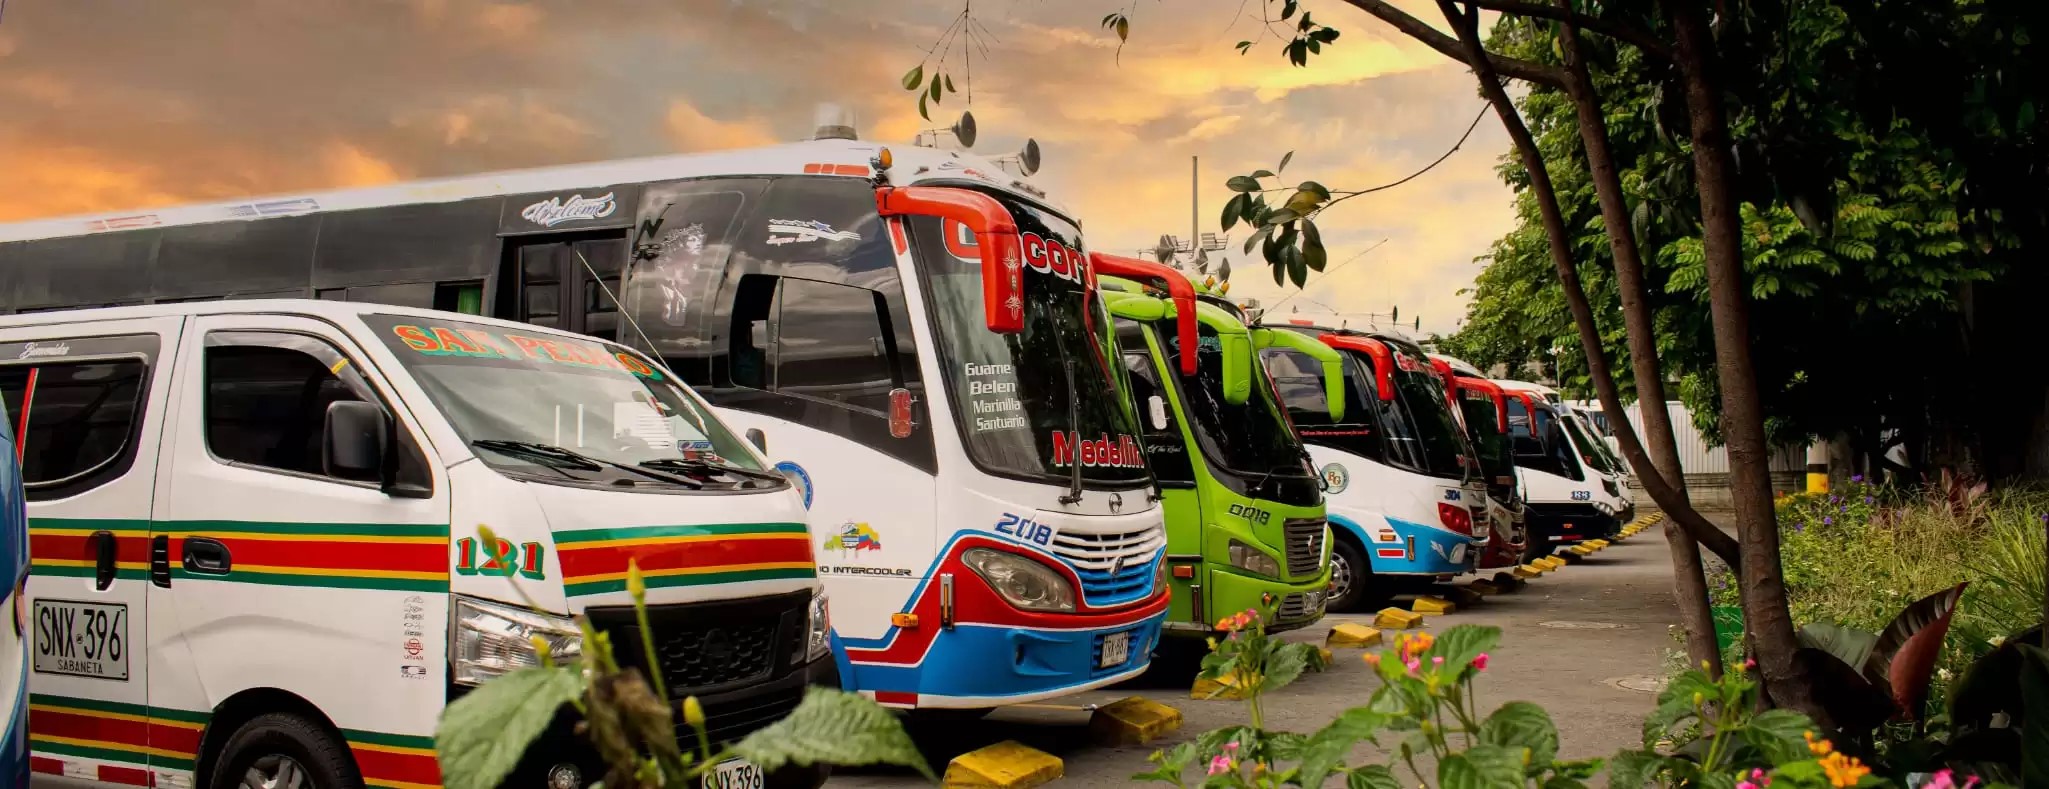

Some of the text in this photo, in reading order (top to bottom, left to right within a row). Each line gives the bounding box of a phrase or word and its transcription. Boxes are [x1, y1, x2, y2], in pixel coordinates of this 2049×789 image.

[522, 192, 616, 227] Welcome
[392, 324, 664, 381] SAN PEDRO
[970, 380, 1016, 395] Belen
[973, 398, 1020, 415] Marinilla
[976, 414, 1025, 431] Santuario
[995, 512, 1053, 546] 208
[456, 535, 546, 581] 121
[833, 566, 912, 576] INTERCOOLER
[40, 606, 121, 662] SNX 396
[57, 659, 104, 675] SABANETA
